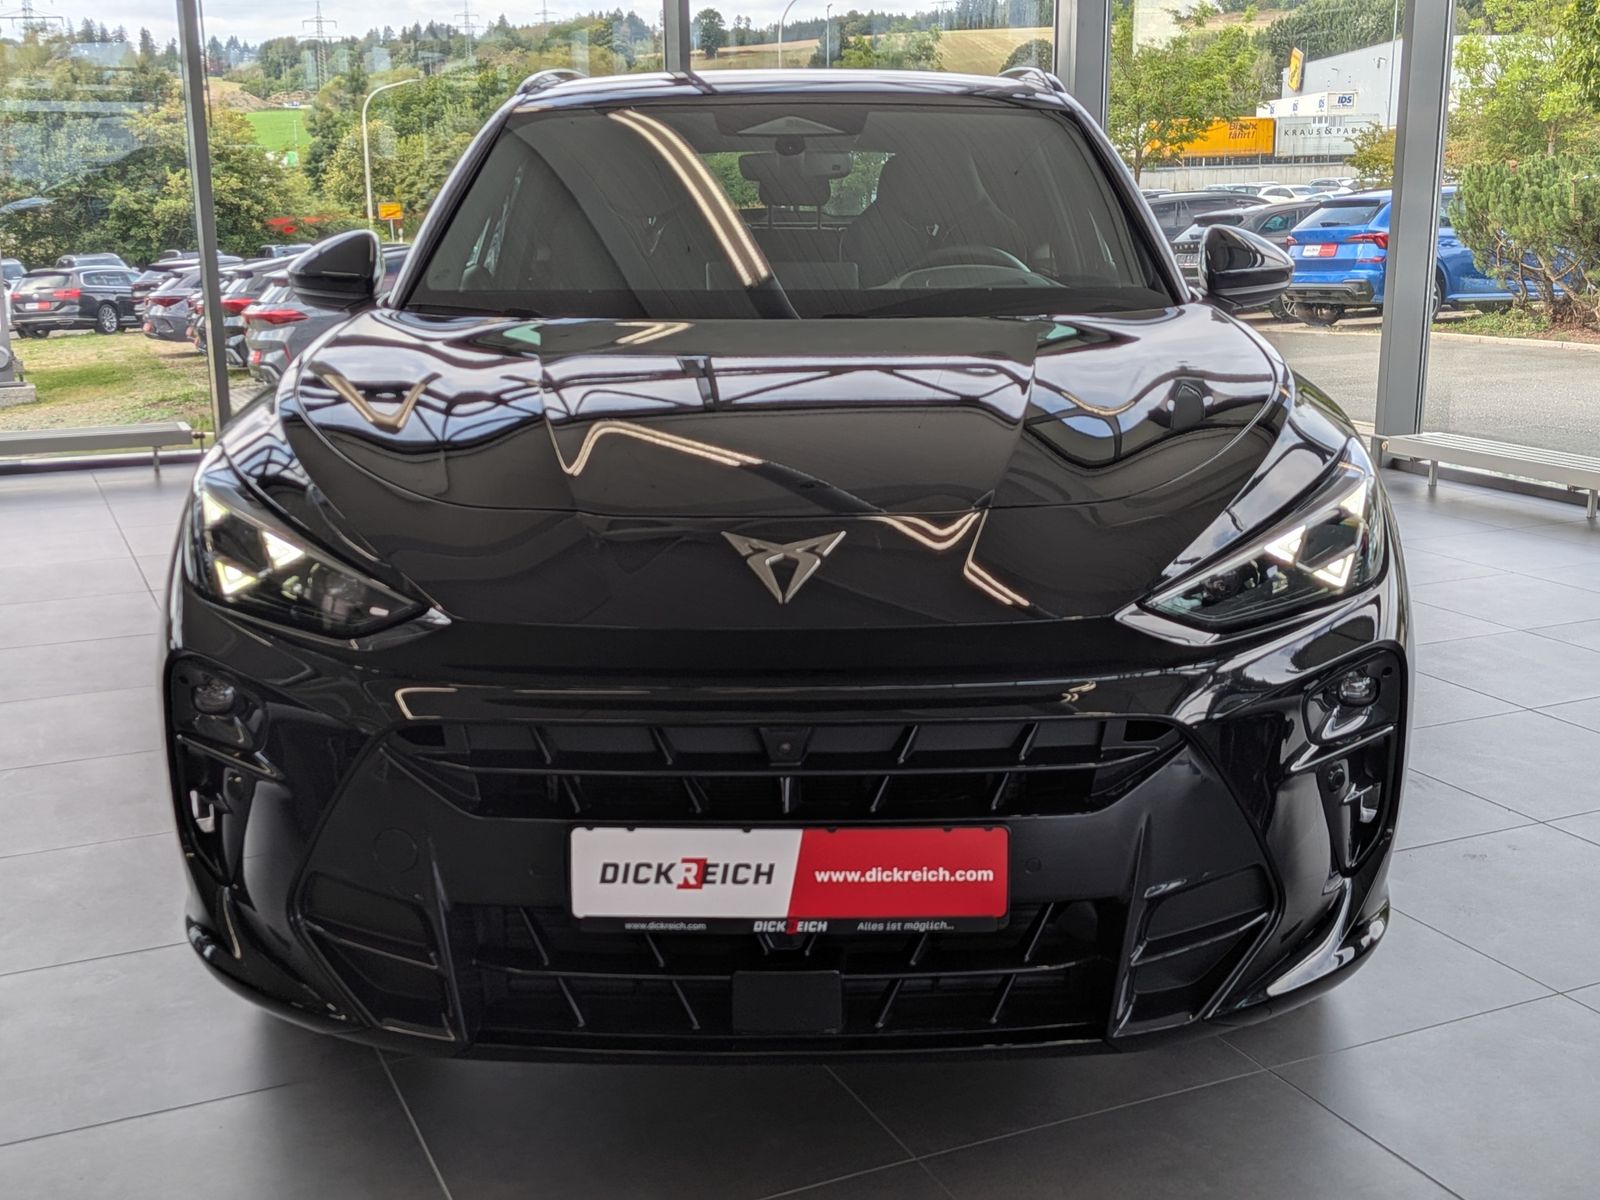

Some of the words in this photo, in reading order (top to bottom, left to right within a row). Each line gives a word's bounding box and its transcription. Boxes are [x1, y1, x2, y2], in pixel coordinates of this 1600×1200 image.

[1337, 96, 1352, 104] IDS
[1283, 128, 1321, 136] KRAUS
[599, 860, 775, 888] DICKREICH
[814, 866, 994, 883] www.dickreich.com
[624, 920, 707, 931] www.dickreich.com
[857, 920, 884, 931] Alles
[886, 920, 901, 931] ist
